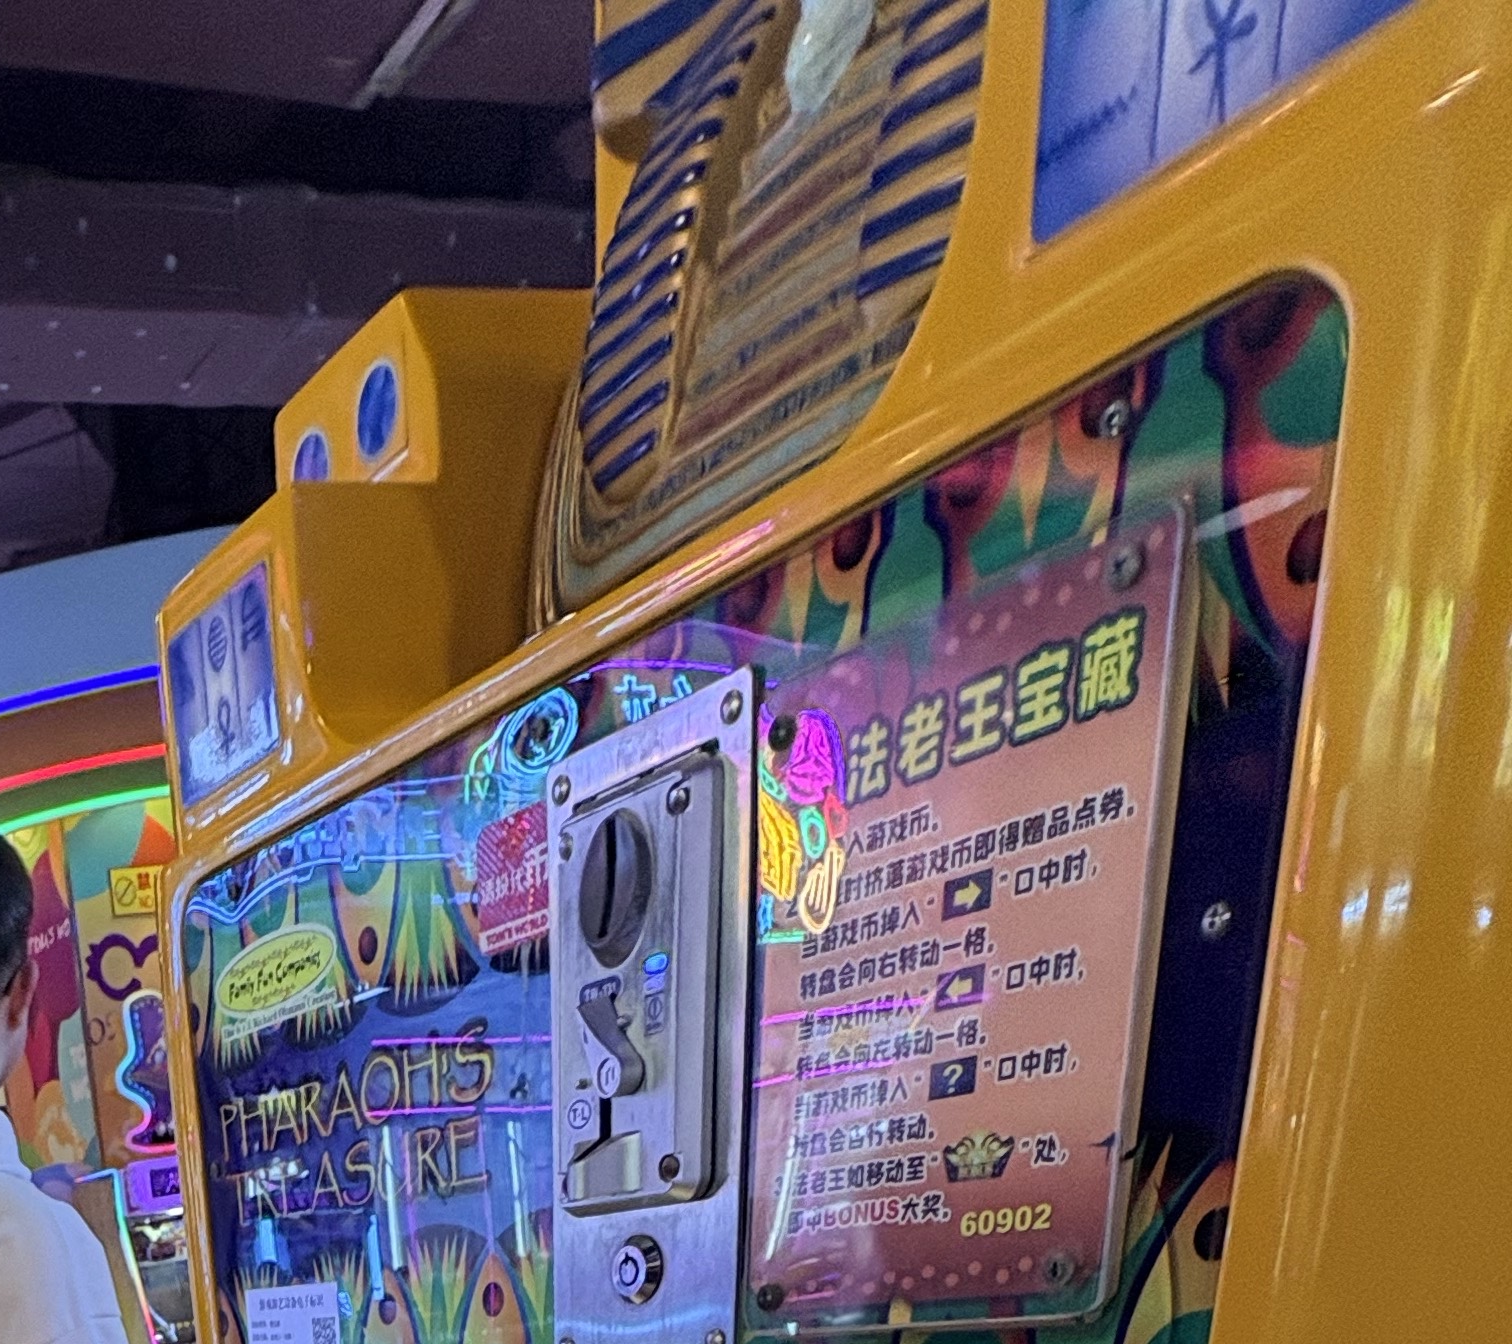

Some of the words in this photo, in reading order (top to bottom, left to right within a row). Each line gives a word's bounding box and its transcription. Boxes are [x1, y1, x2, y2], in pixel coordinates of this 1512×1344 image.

[846, 612, 1143, 806] 法老王宝藏
[219, 1025, 494, 1162] PHARAOH'S
[227, 1114, 489, 1228] TREASURE
[959, 1201, 1054, 1238] 60902
